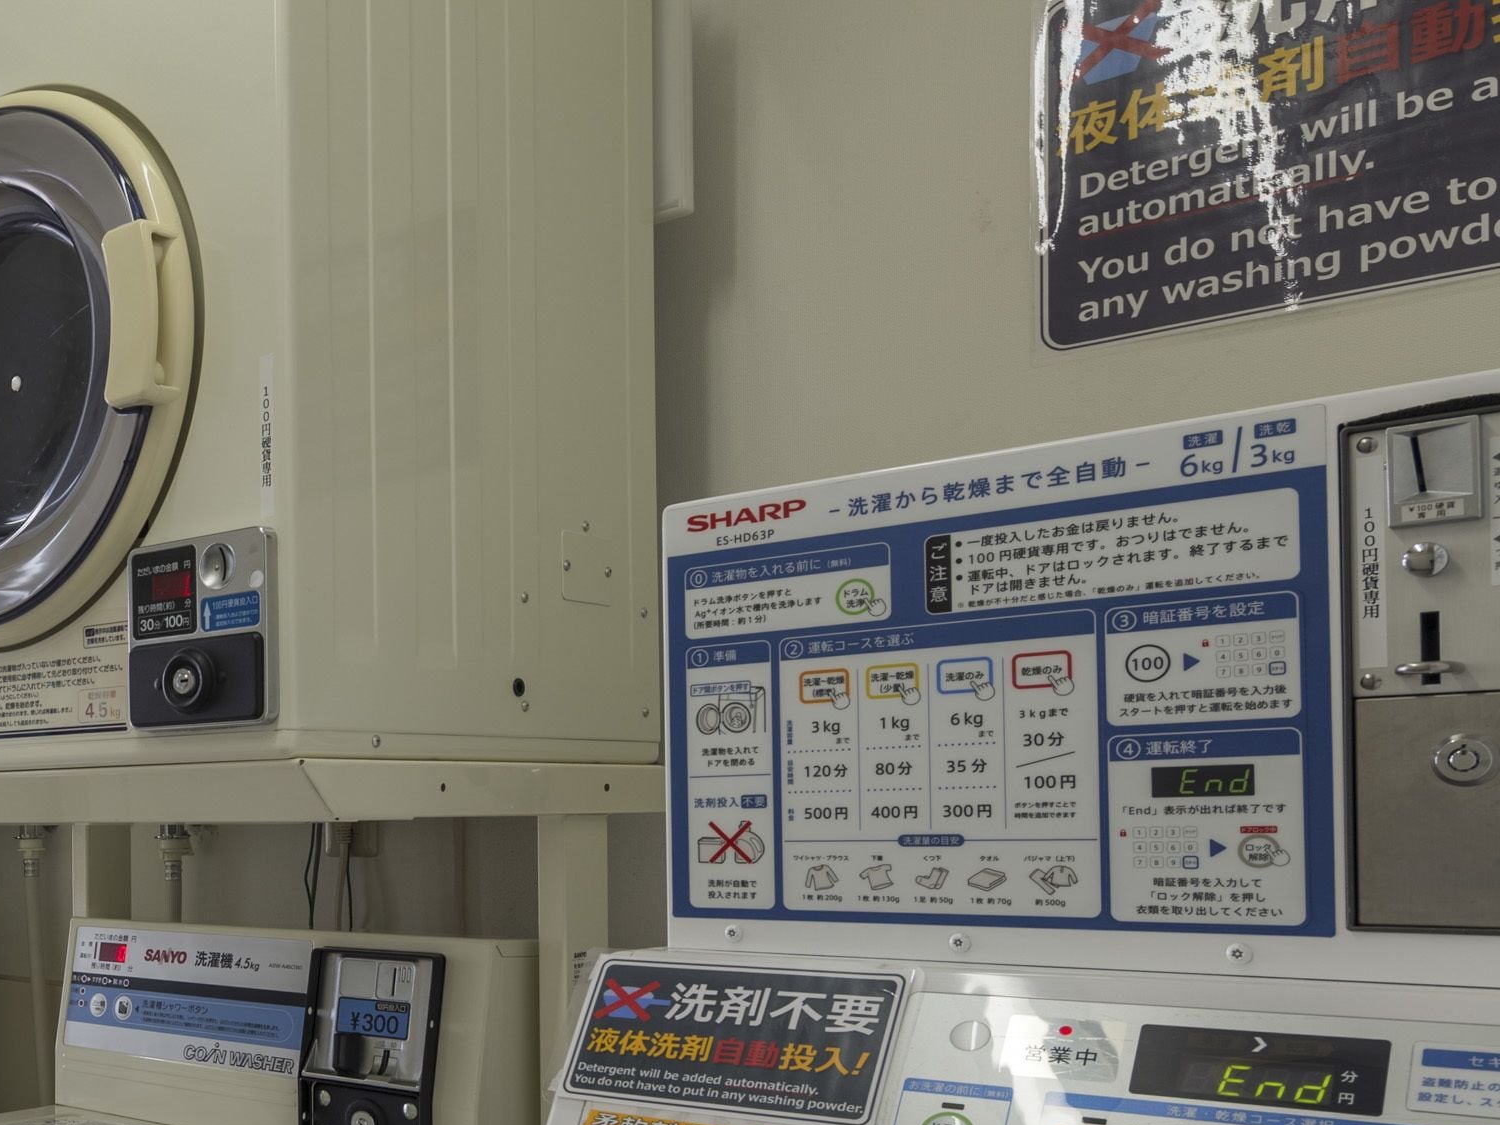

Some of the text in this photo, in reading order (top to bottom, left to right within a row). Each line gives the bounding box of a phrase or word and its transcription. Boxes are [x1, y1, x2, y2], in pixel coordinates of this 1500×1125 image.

[1079, 87, 1454, 199] Detergent will be
[1079, 149, 1375, 237] automatically.
[1079, 176, 1498, 285] You do not have to
[1078, 212, 1500, 323] any washing powd
[1187, 420, 1292, 447] 洗濯 洗乾
[687, 499, 807, 533] SHARP
[716, 529, 775, 546] ES-HD63P
[711, 558, 821, 583] 洗濯物を入れる前に
[929, 542, 948, 603] ご注意
[843, 587, 869, 597] ドラム
[970, 574, 1087, 595] ドアは開きません。
[693, 588, 793, 606] ドラム洗浄ボタンを押すと
[846, 599, 866, 609] 洗浄
[1142, 601, 1265, 625] 暗証番号を設定
[807, 632, 915, 655] 運転コースを選ぶ
[713, 649, 737, 662] 準備
[1131, 656, 1164, 672] 100
[945, 665, 1063, 682] 洗濯のみ 乾燥のみ
[1123, 684, 1287, 703] 硬貨を入れて暗証番号を入力後
[1118, 698, 1293, 718] スタートを押すと運転を始めます
[835, 737, 851, 745] まで
[904, 733, 920, 742] まで
[978, 729, 995, 738] まで
[1145, 738, 1213, 757] 運転終了
[701, 746, 759, 757] 洗濯物を入れて
[707, 757, 756, 767] ドアを閉める
[1179, 768, 1250, 795] End
[1245, 843, 1272, 852] ロック
[1152, 877, 1263, 888] 暗証番号を入力して
[1135, 904, 1284, 918] 衣類を取り出してください
[144, 948, 187, 965] SANYO
[194, 950, 234, 969] 洗濯機
[234, 957, 260, 972] 4.5kg
[663, 981, 885, 1035] 洗剤不要
[349, 1010, 399, 1034] ¥300
[183, 1042, 295, 1075] COIN WASHER
[1025, 1044, 1098, 1066] 営業中
[577, 1061, 819, 1097] Detergent will be added automatically.
[1216, 1065, 1332, 1104] End
[1340, 1070, 1359, 1084] 分
[574, 1072, 864, 1114] You do not have to put in any washing powder.
[1337, 1092, 1355, 1106] 円
[1417, 1091, 1500, 1108] 設定し、ス
